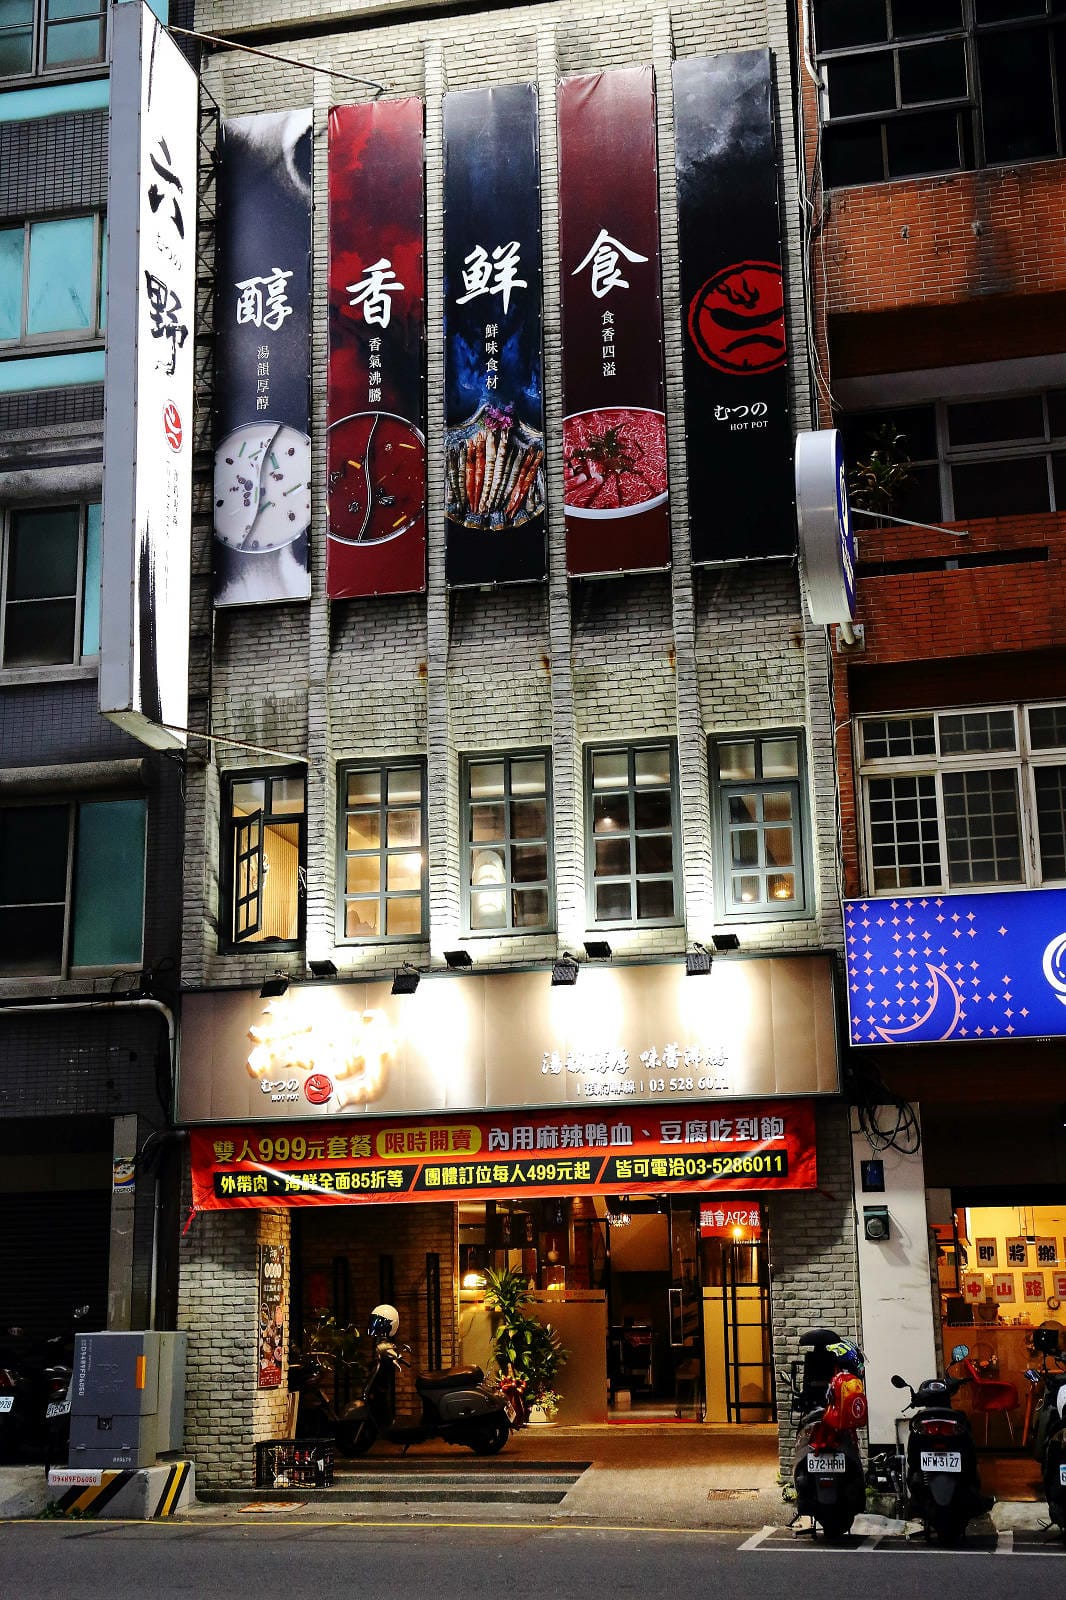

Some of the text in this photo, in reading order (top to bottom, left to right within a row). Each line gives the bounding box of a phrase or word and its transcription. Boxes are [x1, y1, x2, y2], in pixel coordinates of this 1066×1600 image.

[455, 241, 528, 315] 鮮
[571, 228, 649, 299] 食
[235, 267, 294, 331] 醇
[345, 257, 405, 329] 香
[485, 323, 499, 390] 鮮味食材
[601, 310, 617, 377] 食香四溢
[368, 337, 382, 403] 香氣沸騰
[713, 402, 768, 421] むつの
[730, 420, 768, 431] HOT POT
[261, 1079, 300, 1094] むつの
[271, 1094, 300, 1103] HOT POT
[650, 1079, 665, 1092] 03
[670, 1077, 694, 1090] 528
[213, 1135, 372, 1163] 雙人999元套餐
[385, 1129, 472, 1154] 限時開賣
[220, 1155, 783, 1194] 外帶肉、海鮮全面85折等 團體訂位每人499元起 皆可電洽03-5286011
